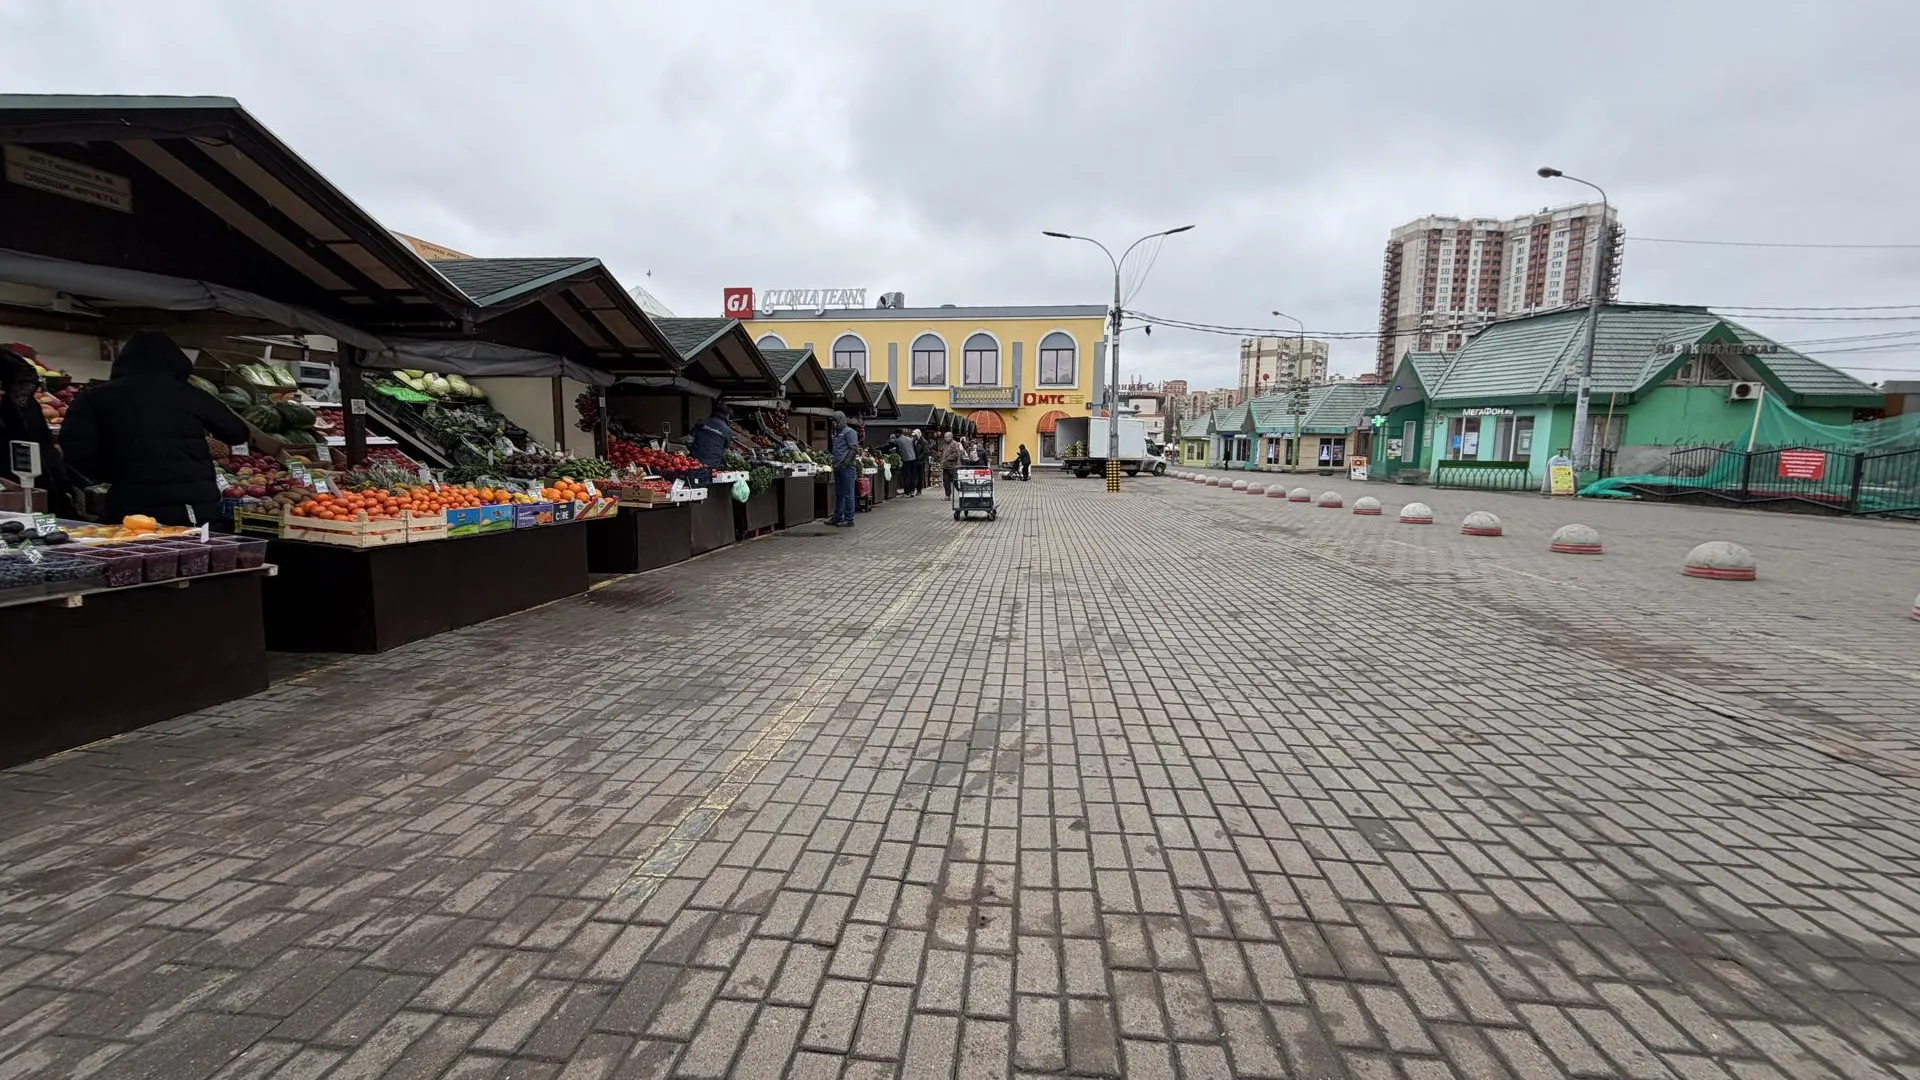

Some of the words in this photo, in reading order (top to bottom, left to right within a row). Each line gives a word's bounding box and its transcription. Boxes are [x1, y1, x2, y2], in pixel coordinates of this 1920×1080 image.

[727, 294, 748, 312] GJ
[761, 289, 818, 315] GLORIA
[815, 288, 867, 315] JEANS
[1038, 394, 1065, 405] МТС
